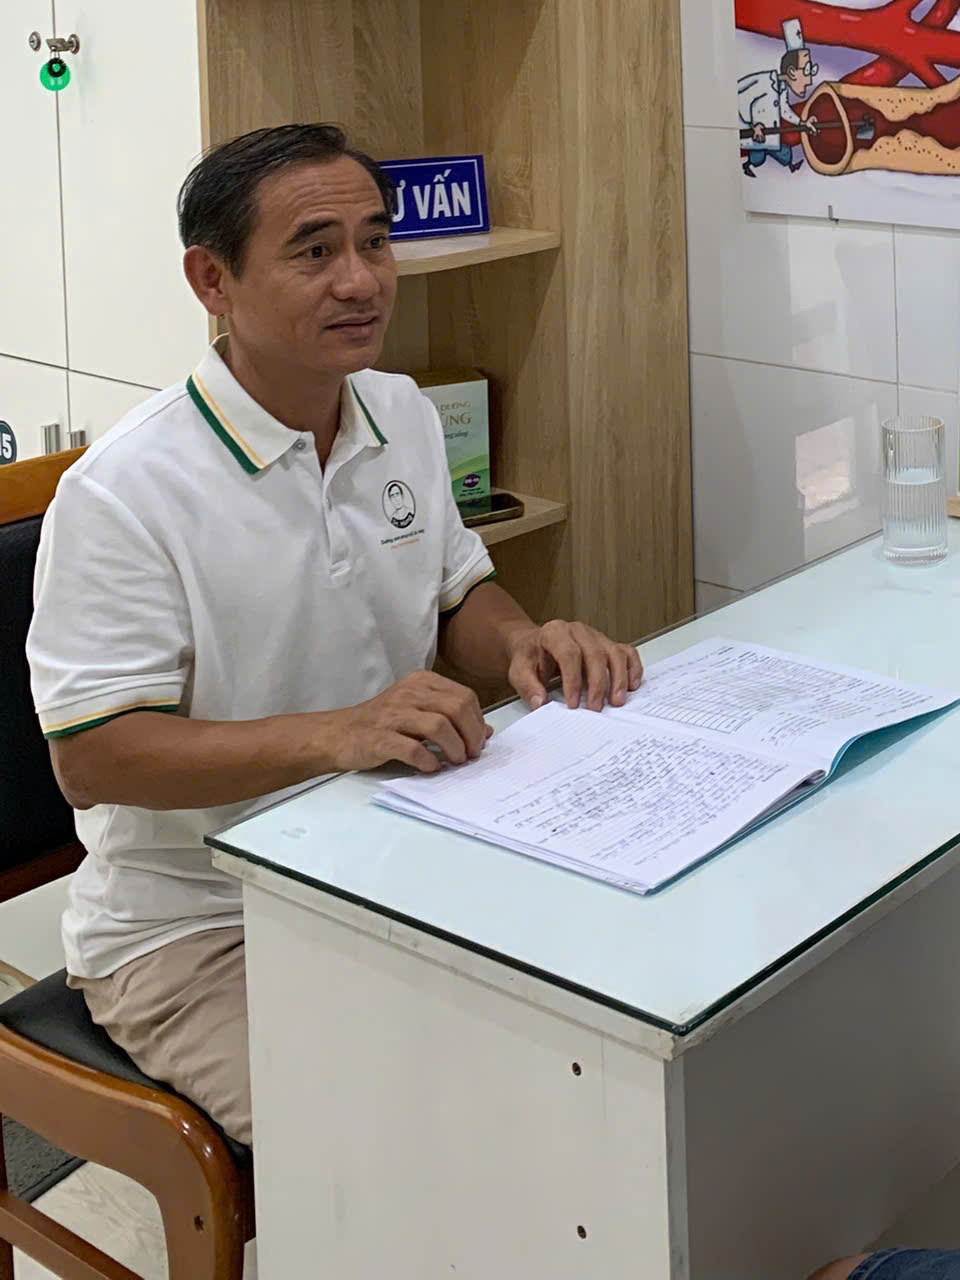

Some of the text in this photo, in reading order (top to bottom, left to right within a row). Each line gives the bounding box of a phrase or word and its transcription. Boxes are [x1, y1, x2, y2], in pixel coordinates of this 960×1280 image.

[391, 168, 472, 223] Ư VẤN
[0, 432, 13, 459] 5
